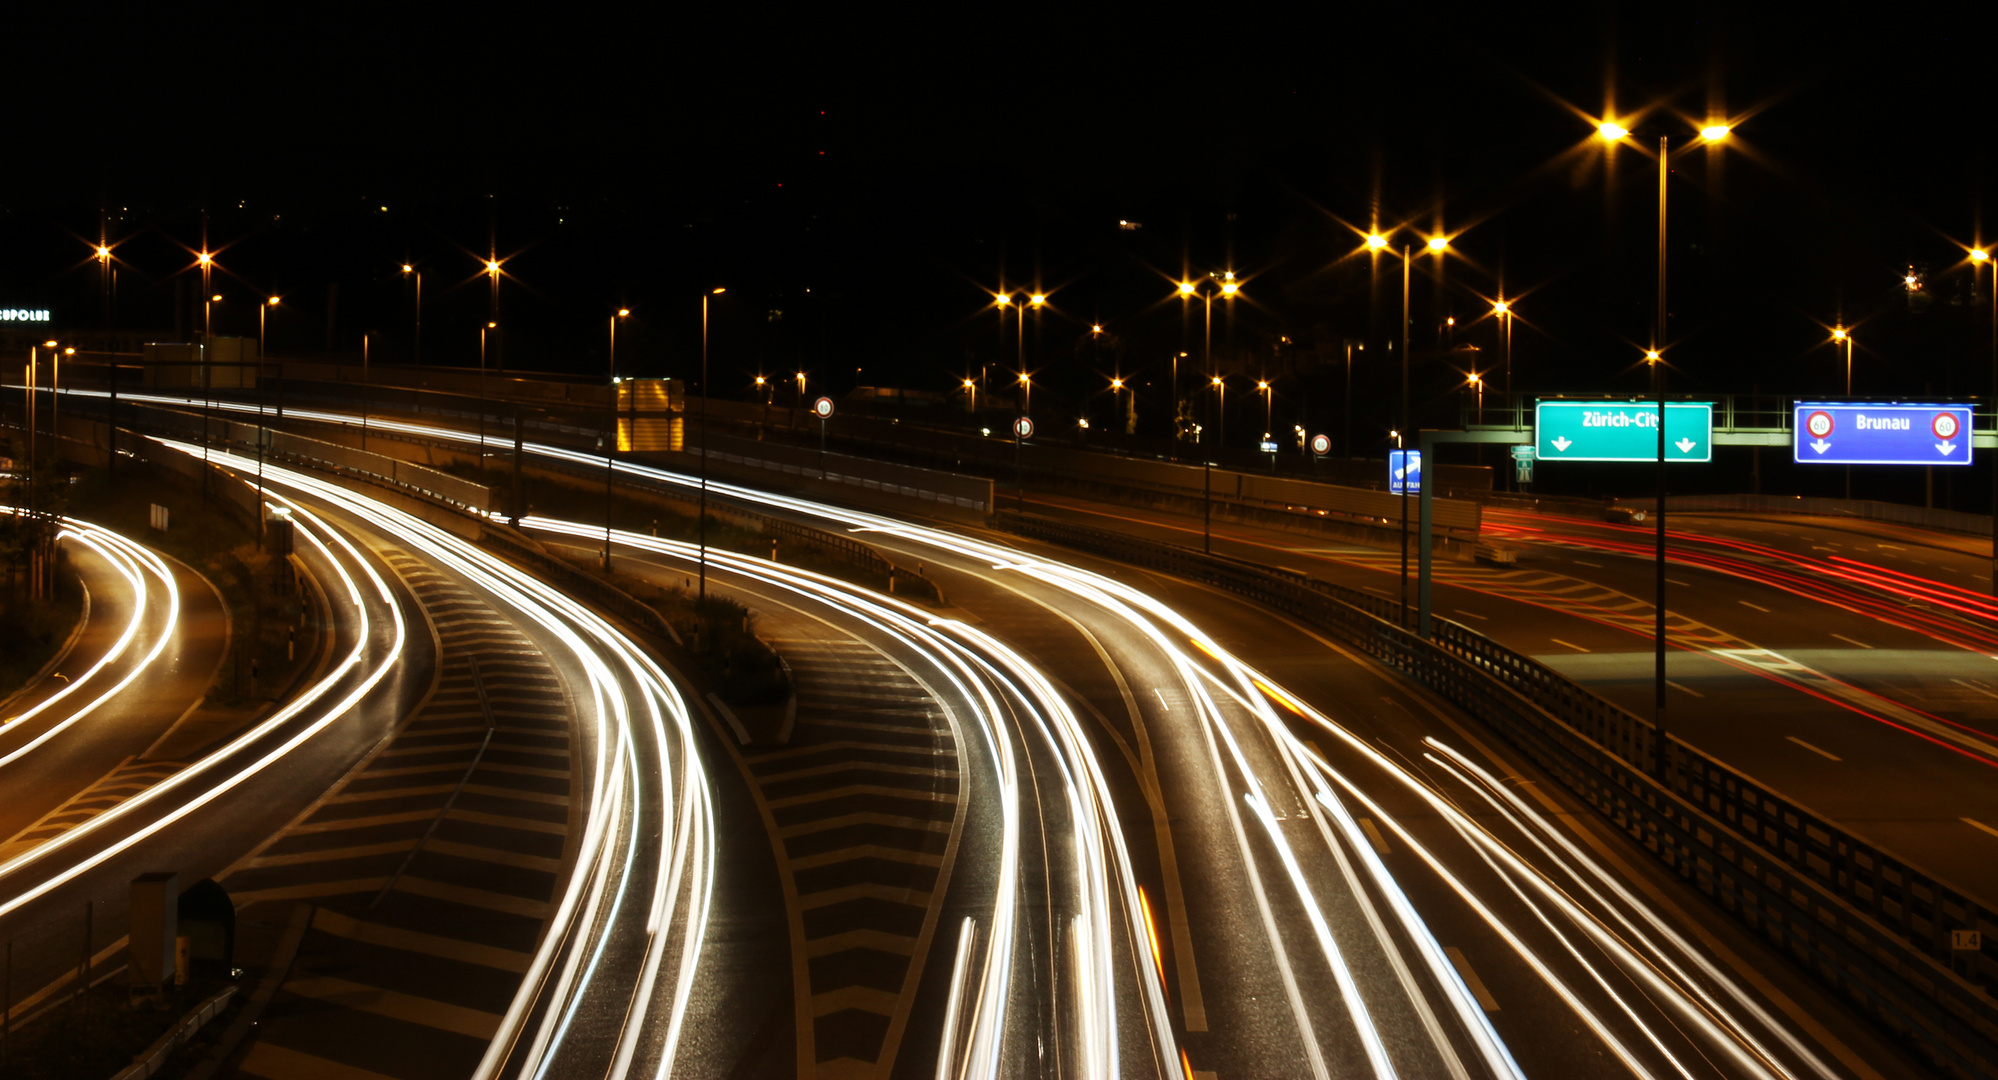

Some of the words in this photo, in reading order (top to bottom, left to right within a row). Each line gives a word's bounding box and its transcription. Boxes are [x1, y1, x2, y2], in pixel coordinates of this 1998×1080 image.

[1813, 420, 1826, 430] 60
[1856, 414, 1910, 430] Brunau
[1939, 421, 1952, 432] 60
[1955, 932, 1978, 947] 1.4
